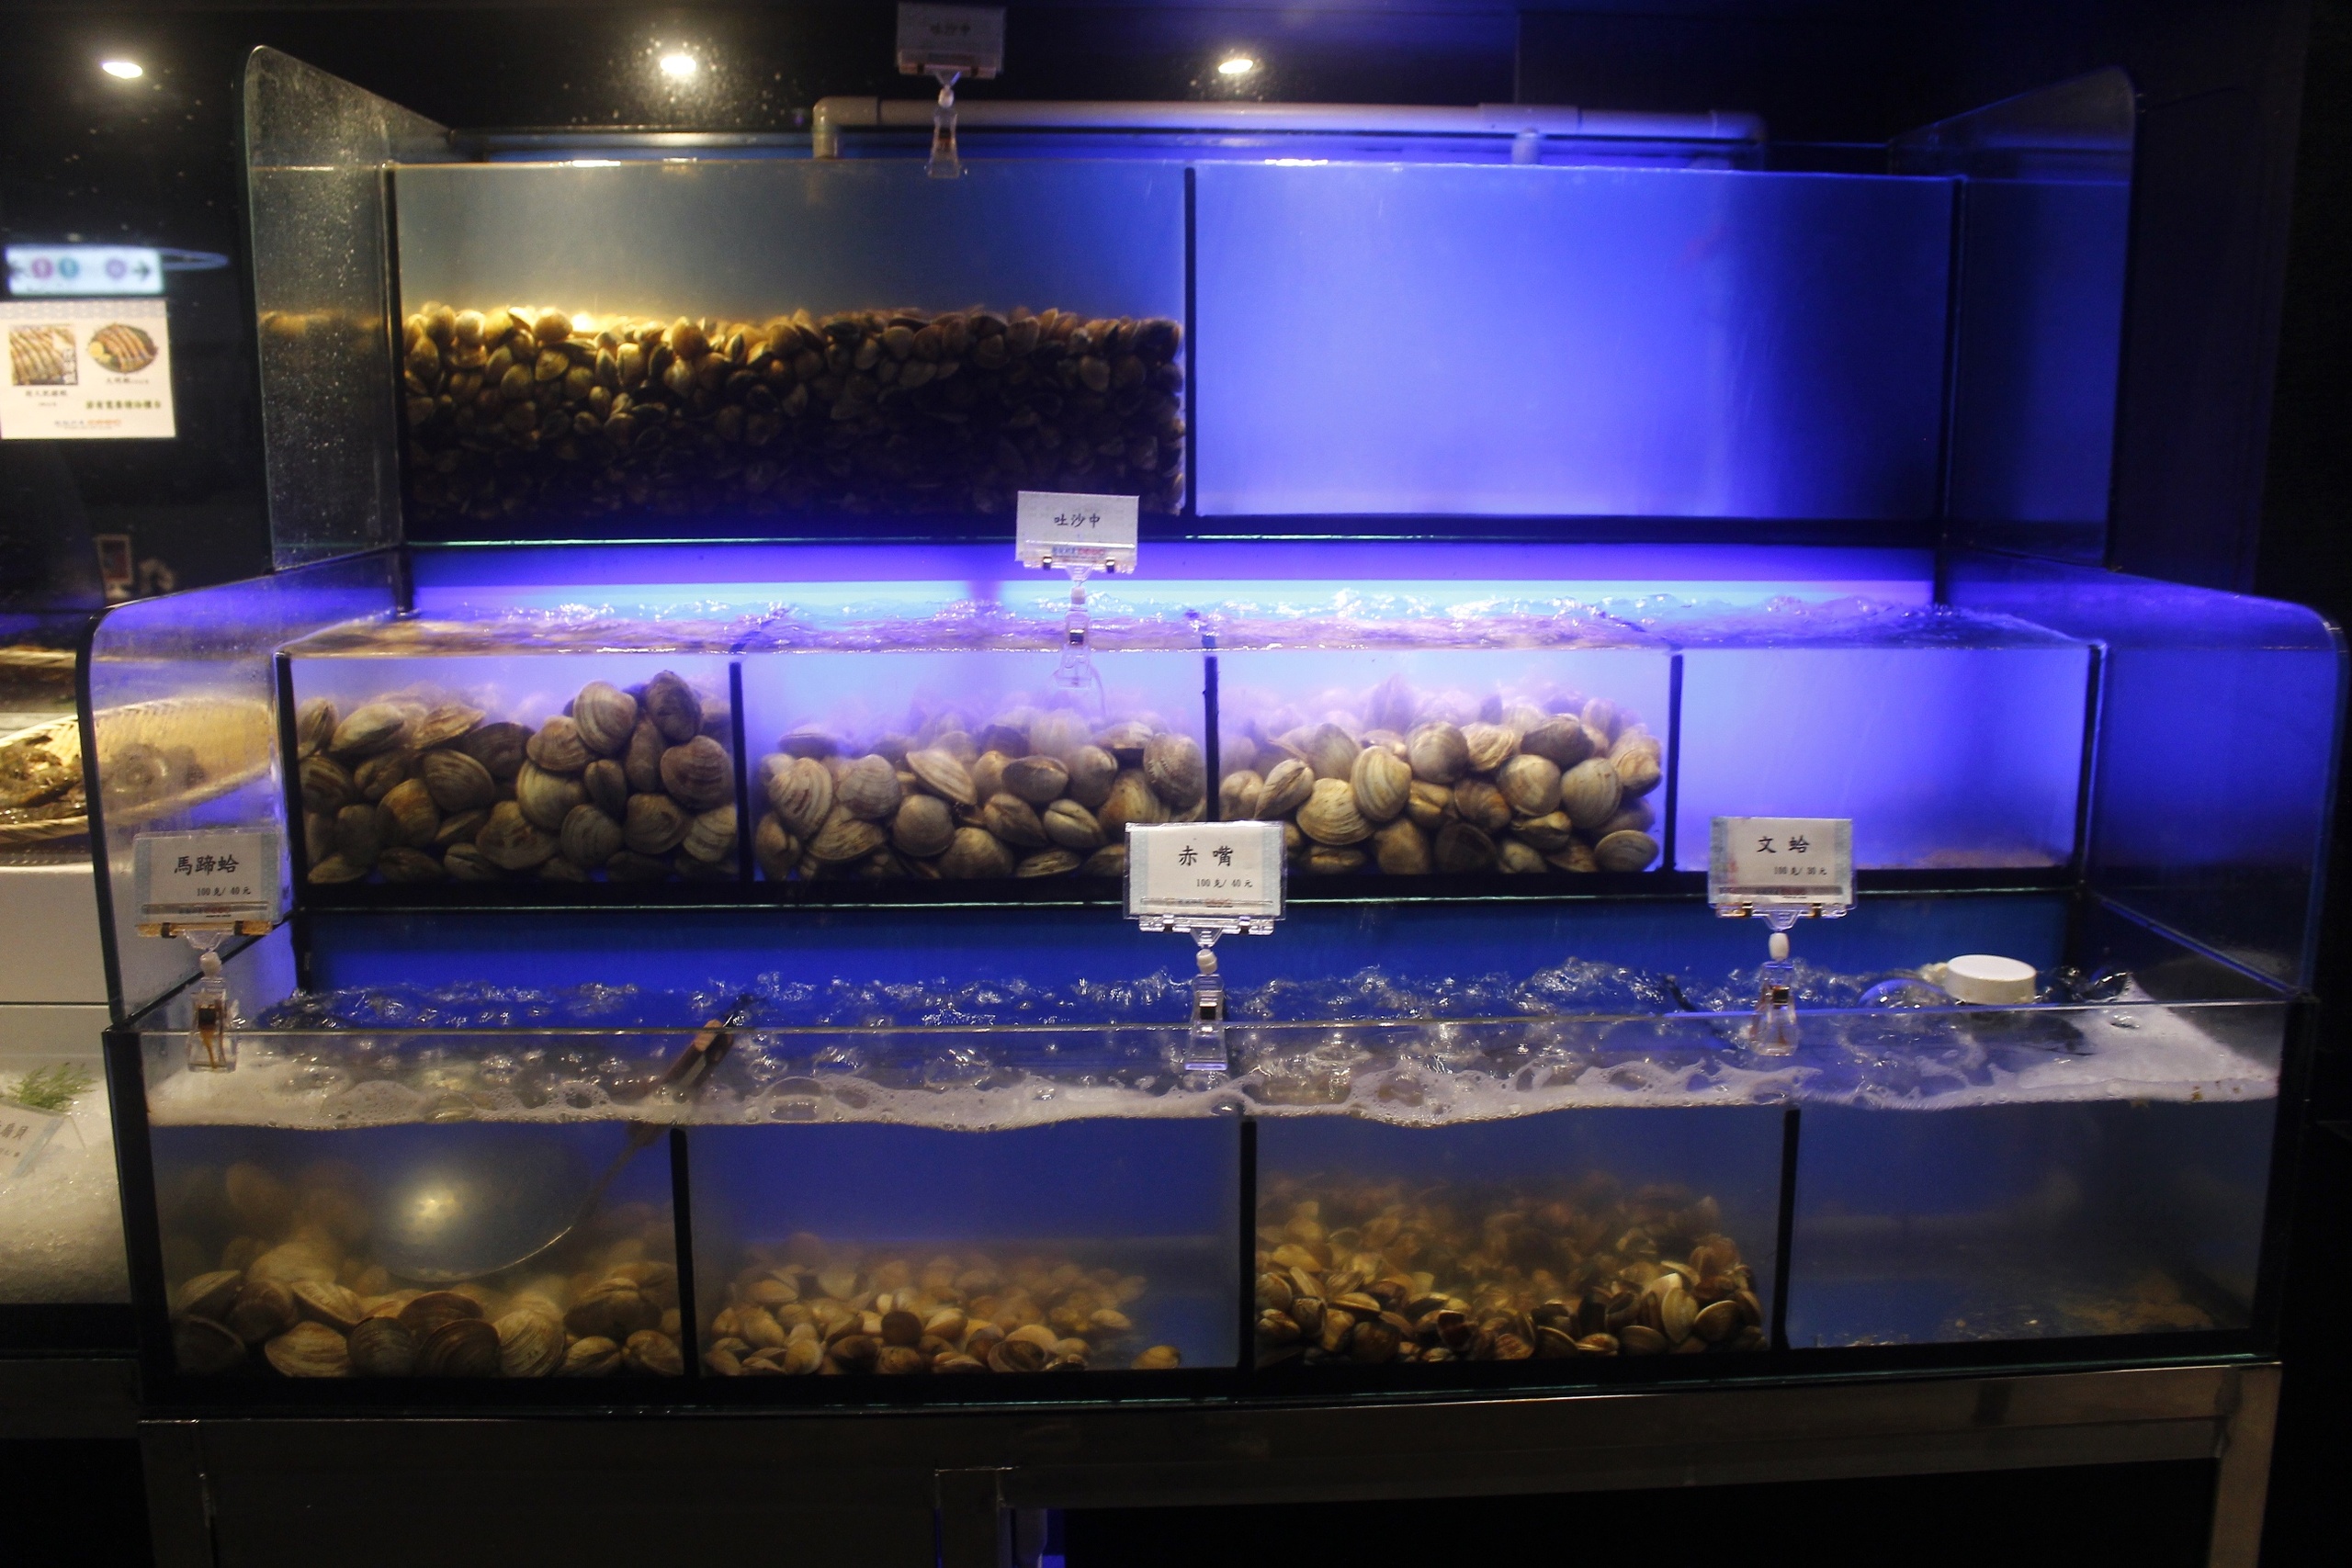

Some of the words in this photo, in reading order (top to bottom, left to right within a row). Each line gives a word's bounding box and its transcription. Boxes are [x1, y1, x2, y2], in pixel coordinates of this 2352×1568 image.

[1054, 513, 1101, 528] 吐沙中
[1756, 834, 1810, 853] 文蛤
[174, 854, 239, 875] 馬蹄蛤
[1178, 845, 1234, 867] 赤嘴
